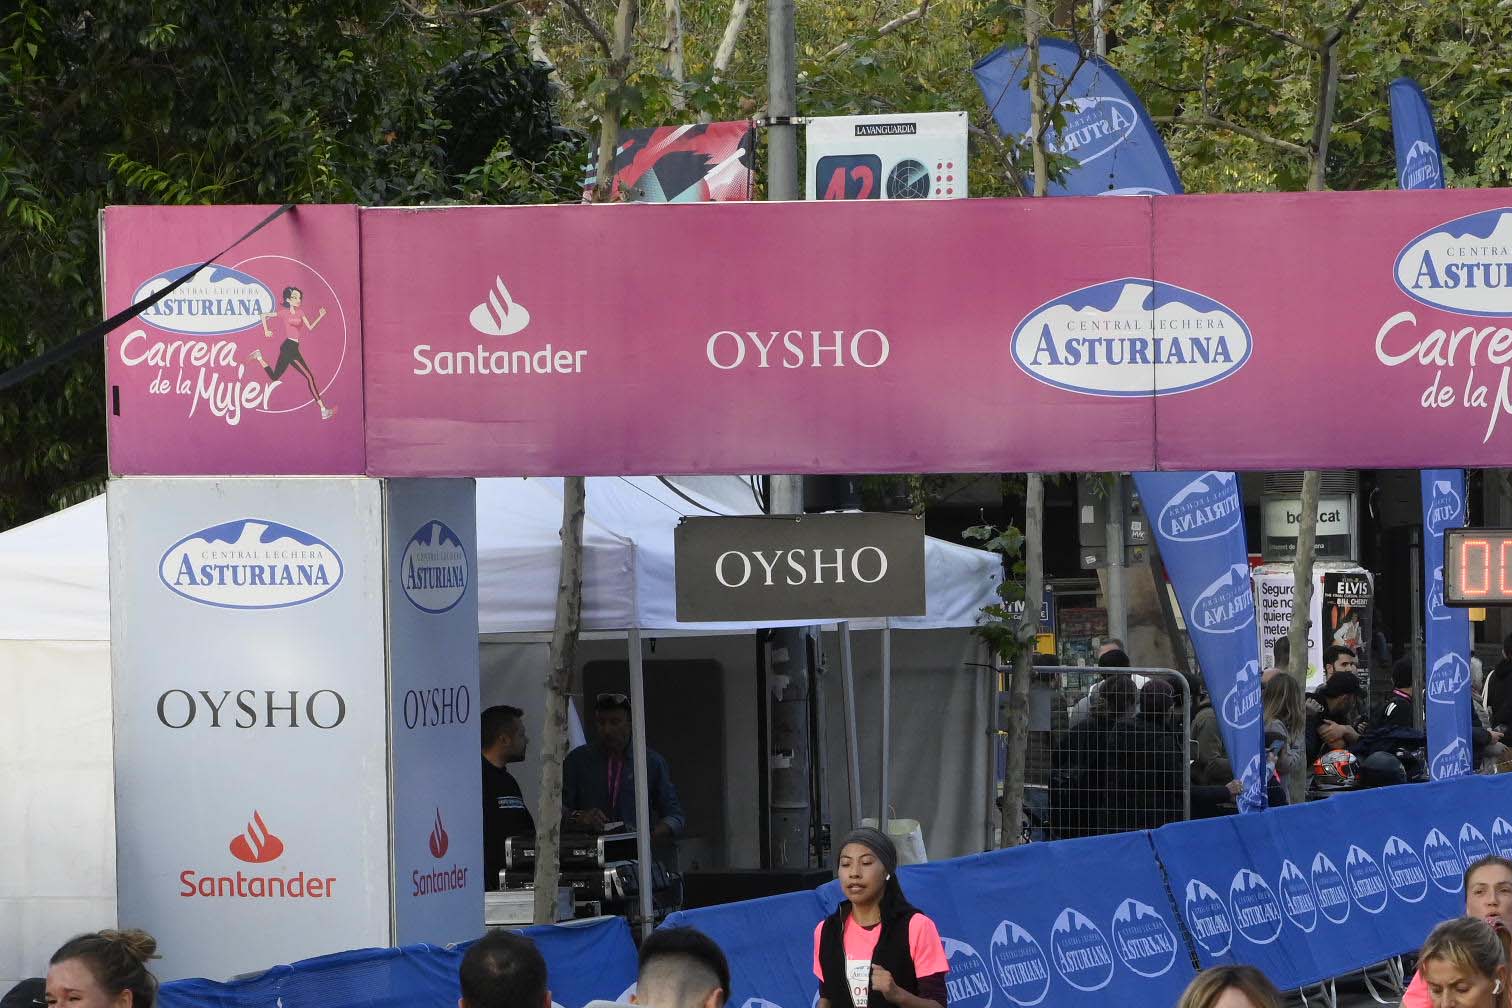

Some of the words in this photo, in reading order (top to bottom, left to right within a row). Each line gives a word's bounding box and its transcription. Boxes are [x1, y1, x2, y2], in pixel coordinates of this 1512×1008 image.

[856, 126, 867, 135] LA
[866, 124, 916, 135] VANGUARDIA
[143, 289, 264, 317] ASTURIANA
[168, 288, 210, 297] ENTRAL
[214, 286, 260, 296] LECHERA
[1067, 319, 1139, 332] CENTRAL
[1150, 317, 1226, 329] LECHERA
[120, 330, 238, 368] Carrera
[413, 344, 588, 375] Santander
[706, 329, 890, 369] OYSHO
[1029, 323, 1234, 366] ASTURIANA
[149, 374, 171, 395] de
[175, 373, 191, 395] la
[189, 364, 282, 426] Mujer
[1421, 370, 1455, 408] de
[1463, 368, 1487, 408] la
[174, 552, 330, 587] ASTURIANA
[202, 550, 258, 560] CENTRAL
[265, 550, 324, 559] LECHERA
[714, 546, 889, 588] OYSHO
[406, 555, 465, 590] ASTURIANA
[1337, 581, 1368, 595] ELVIS
[1262, 599, 1279, 609] que
[156, 688, 347, 729] OYSHO
[403, 684, 471, 730] OYSHO
[179, 869, 337, 898] Santander
[412, 864, 468, 897] Santander
[999, 955, 1047, 988] ASTURIANA
[1056, 941, 1112, 974] ASTURIANA
[854, 986, 868, 996] 01
